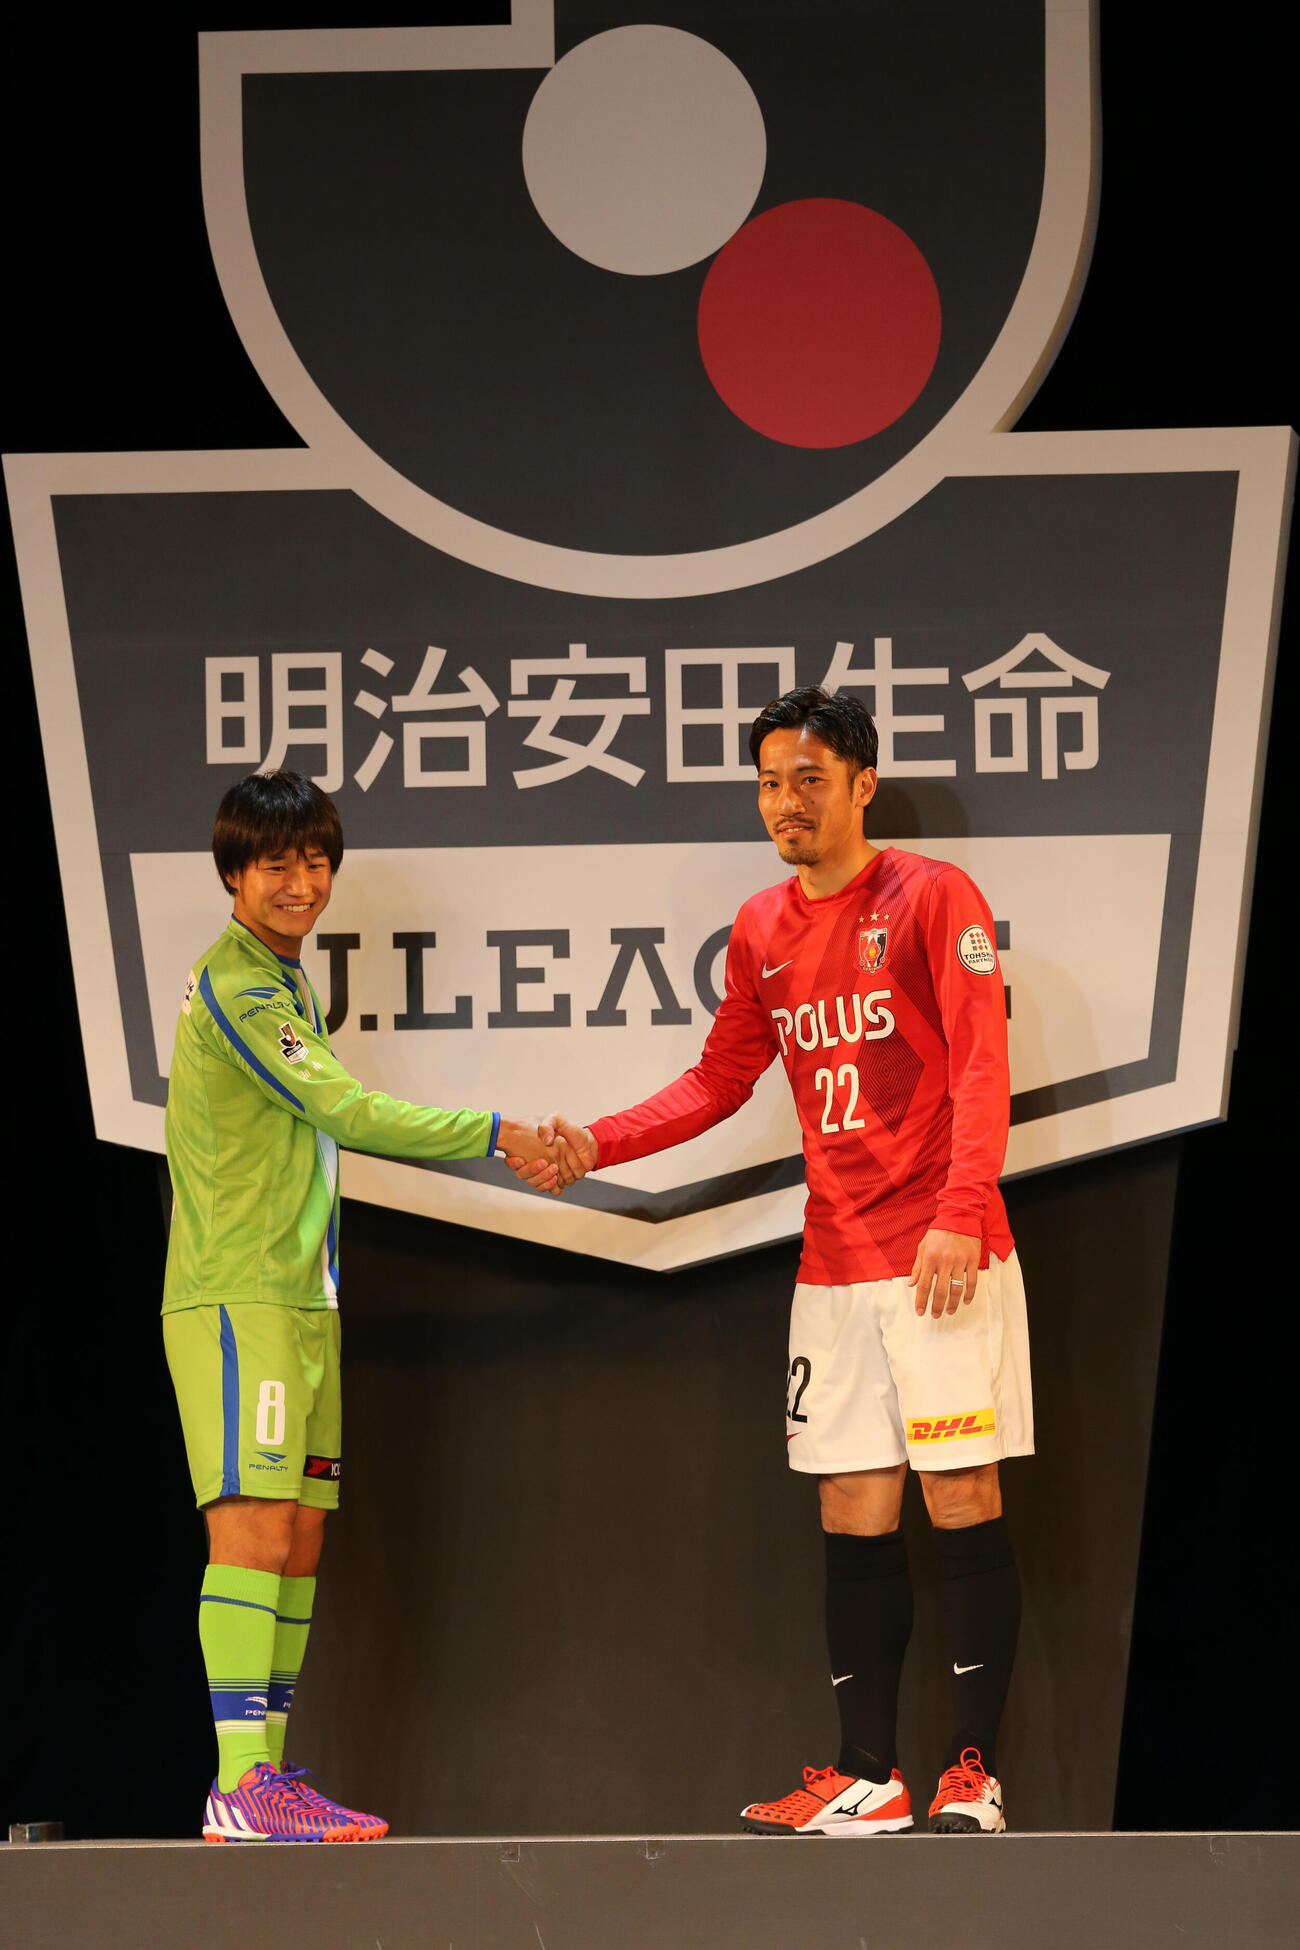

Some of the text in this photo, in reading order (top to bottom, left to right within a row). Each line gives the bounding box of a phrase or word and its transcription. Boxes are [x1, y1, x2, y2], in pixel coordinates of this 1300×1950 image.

[205, 633, 1111, 793] 明治安田生命
[316, 920, 1011, 1036] J.LEA
[771, 989, 896, 1056] POLUS
[815, 1063, 866, 1134] 22
[256, 1380, 285, 1446] 8
[786, 1356, 811, 1423] 2
[911, 1415, 984, 1440] DHL
[248, 1463, 288, 1472] PENALTY
